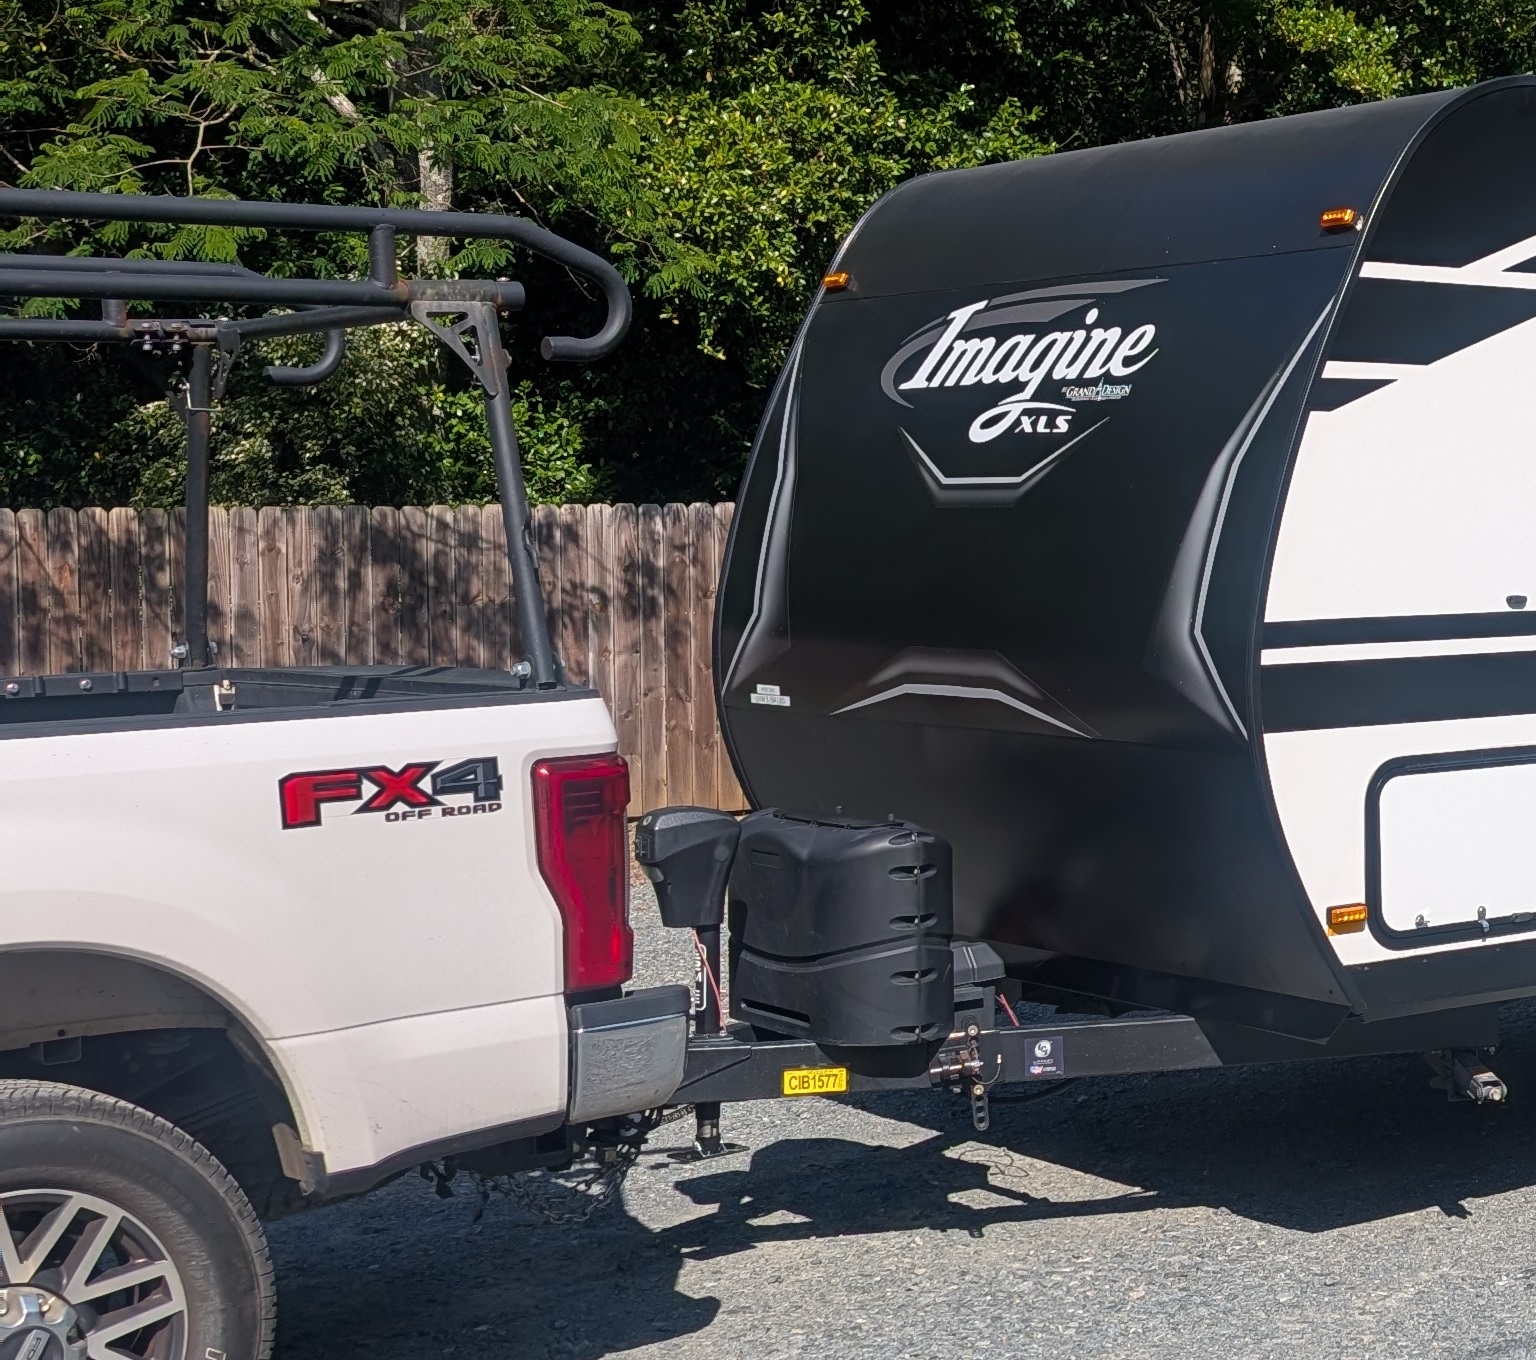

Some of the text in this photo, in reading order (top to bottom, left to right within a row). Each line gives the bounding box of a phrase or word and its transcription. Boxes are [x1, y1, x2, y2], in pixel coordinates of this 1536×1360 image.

[898, 299, 1159, 443] Imagine
[1014, 415, 1072, 433] XLS
[278, 756, 504, 830] FX4
[385, 802, 503, 822] OFF ROAD
[789, 1074, 838, 1090] CIB1577
